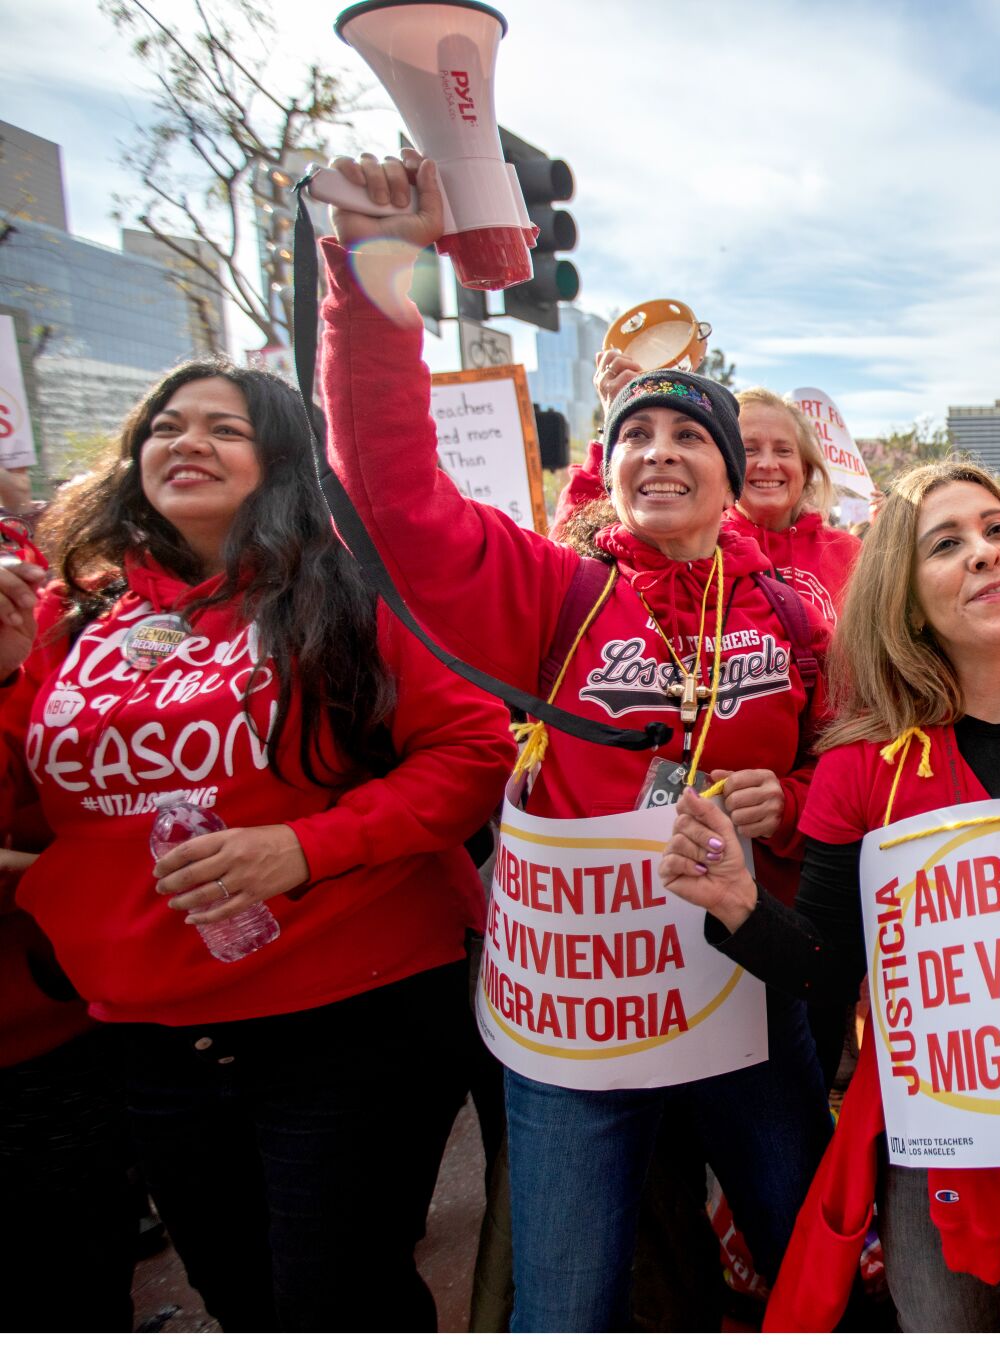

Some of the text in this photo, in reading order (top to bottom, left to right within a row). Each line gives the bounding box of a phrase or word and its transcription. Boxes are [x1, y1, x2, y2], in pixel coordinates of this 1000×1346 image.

[431, 392, 494, 419] eachers
[438, 428, 461, 446] eed
[445, 452, 486, 468] Than
[587, 637, 661, 687] Los
[151, 669, 226, 710] the
[46, 700, 81, 716] NBCT
[503, 912, 686, 979] VIVIENDA
[875, 876, 920, 1096] JUSTICIA
[917, 944, 971, 1009] DE
[890, 1136, 906, 1154] UTLA
[908, 1136, 974, 1147] UNITED TEACHERS
[909, 1146, 956, 1155] LOS ANGELES
